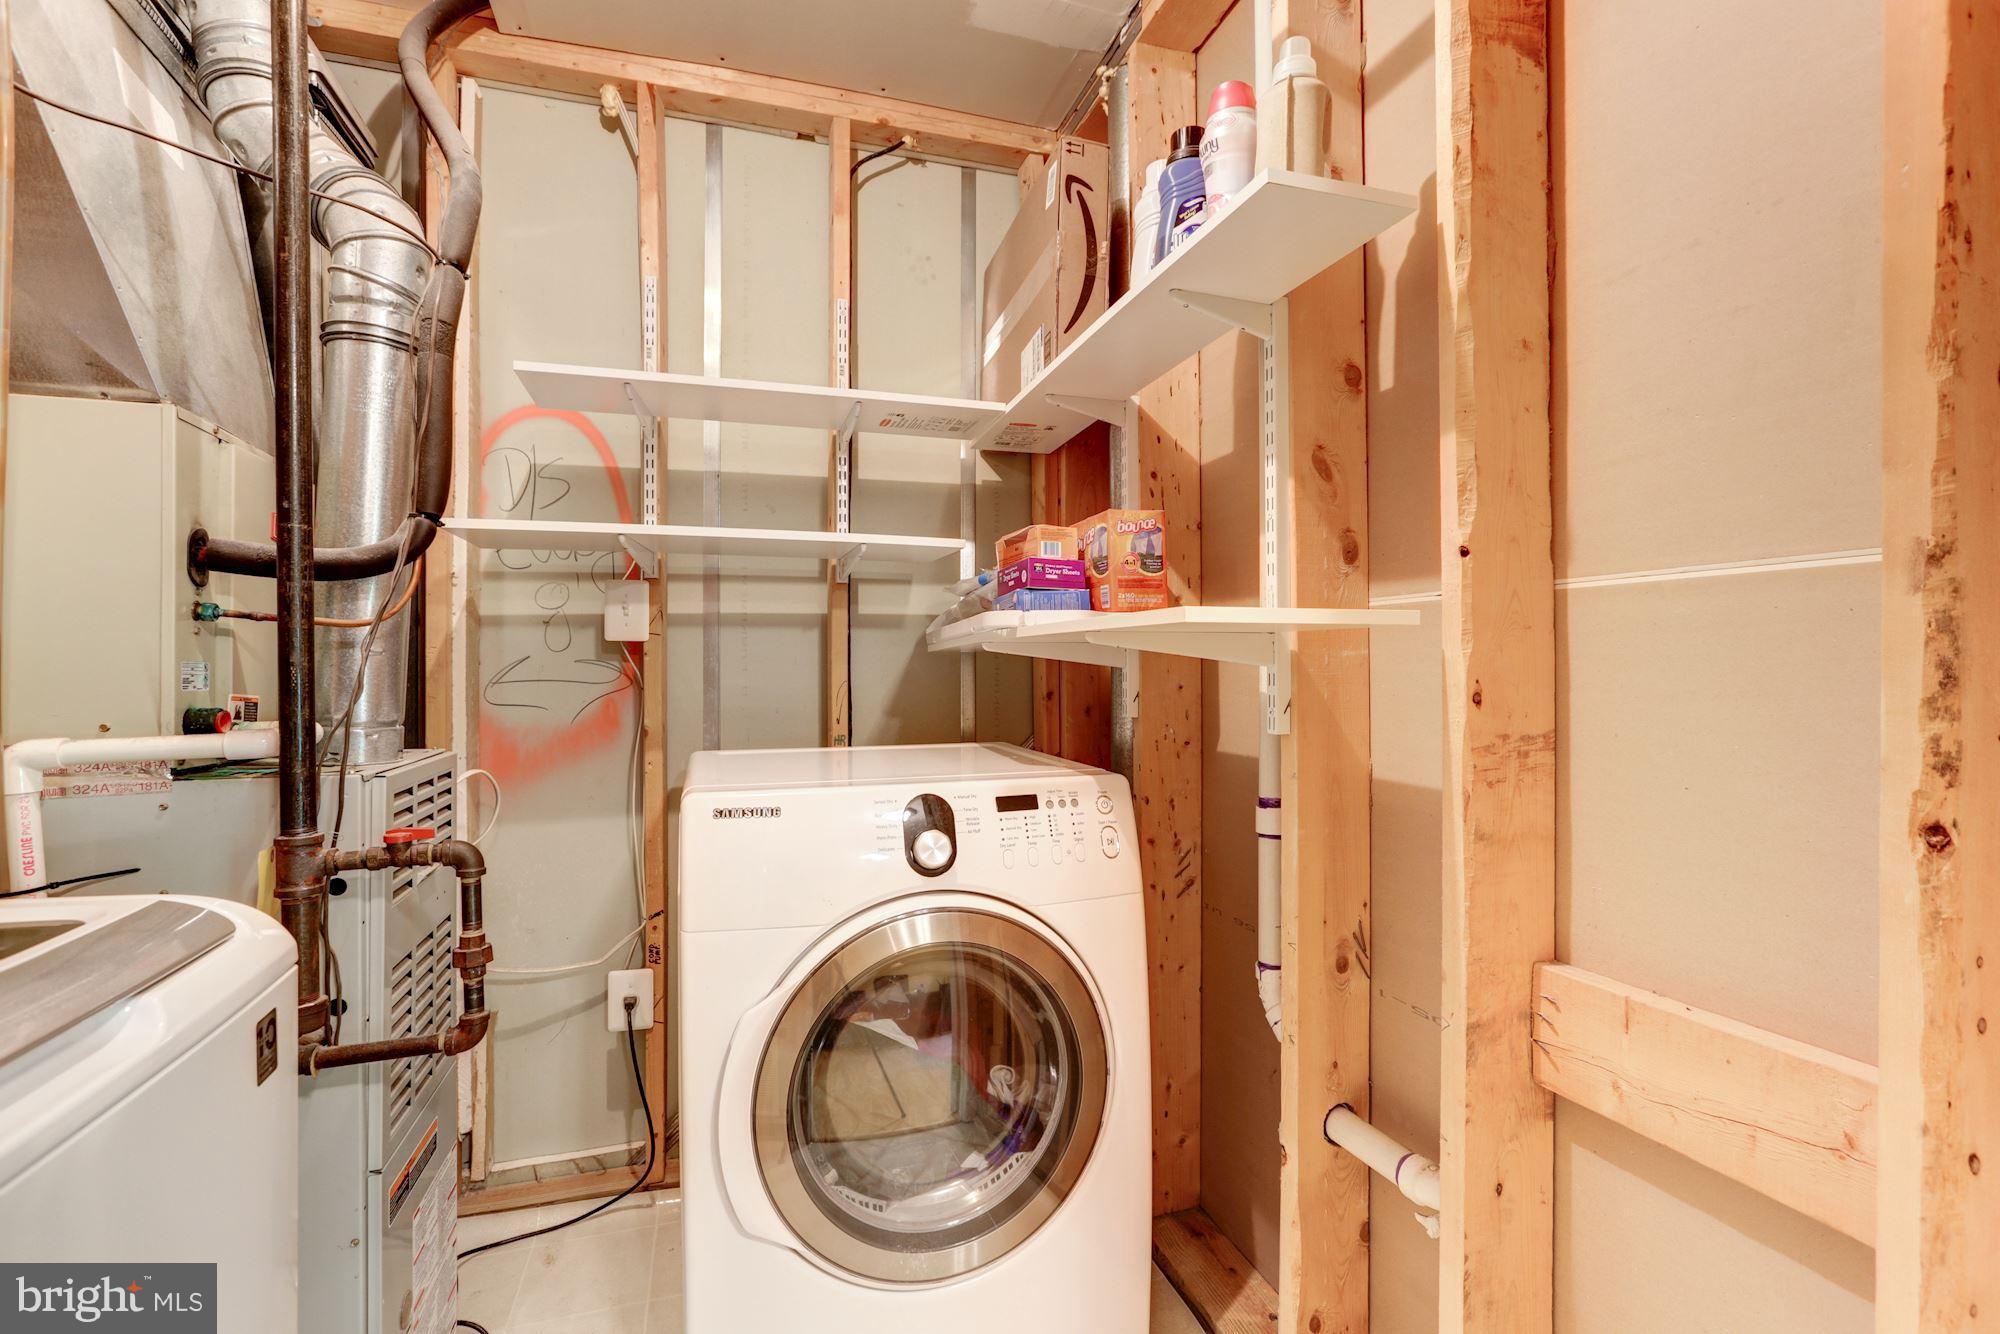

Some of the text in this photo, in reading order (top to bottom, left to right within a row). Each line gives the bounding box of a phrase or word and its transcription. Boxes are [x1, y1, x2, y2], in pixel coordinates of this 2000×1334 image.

[1117, 518, 1157, 533] bounce
[1045, 567, 1081, 576] Dryer Sheets
[72, 782, 110, 795] 324A
[713, 806, 781, 820] SAMSUNG
